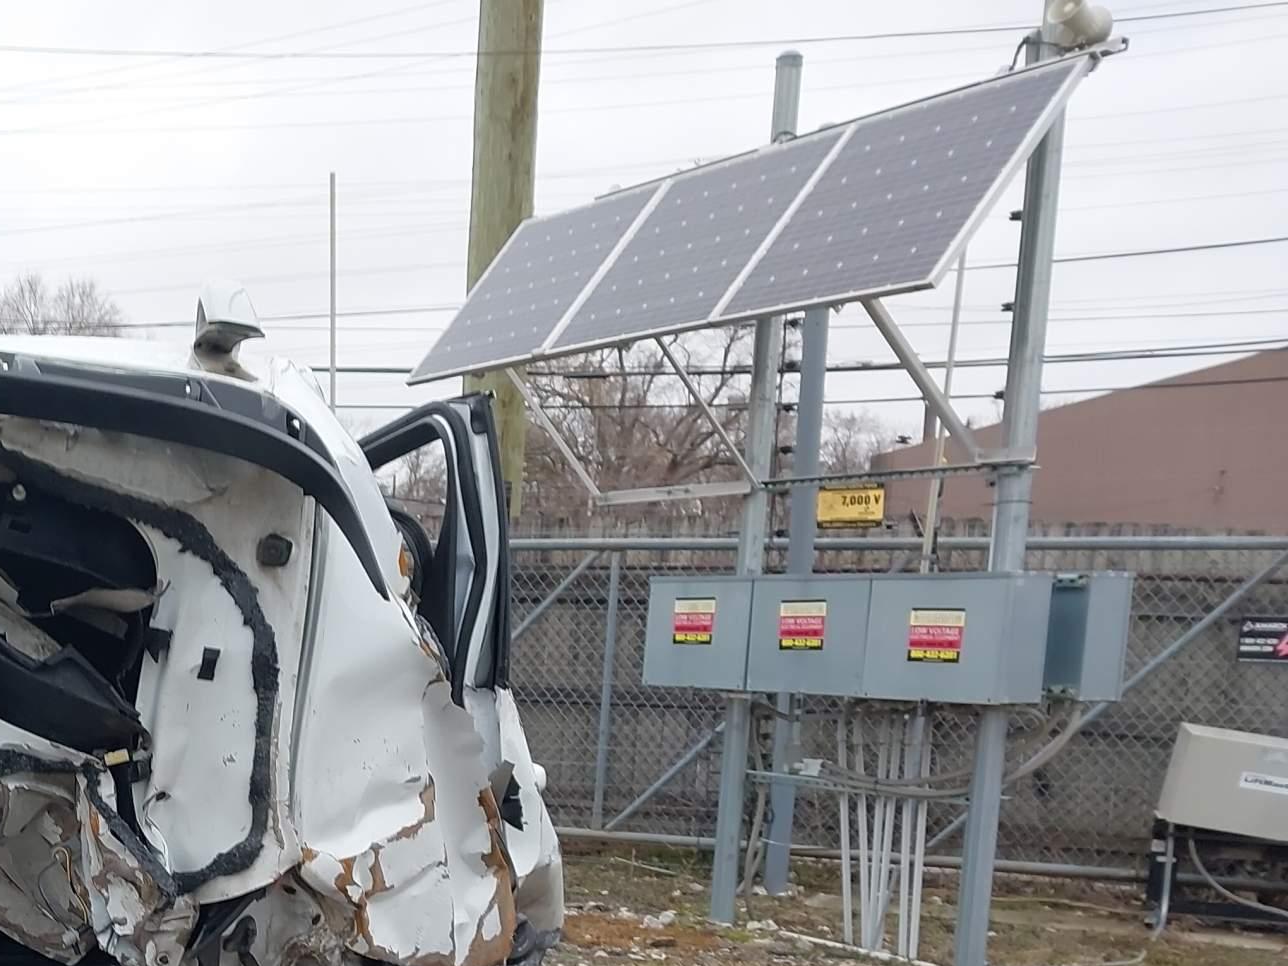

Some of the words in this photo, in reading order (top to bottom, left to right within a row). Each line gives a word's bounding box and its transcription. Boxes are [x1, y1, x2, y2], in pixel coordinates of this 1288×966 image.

[841, 495, 870, 507] 7,000
[873, 494, 881, 505] V
[911, 626, 928, 634] LOW
[928, 626, 960, 636] VOLTAGE
